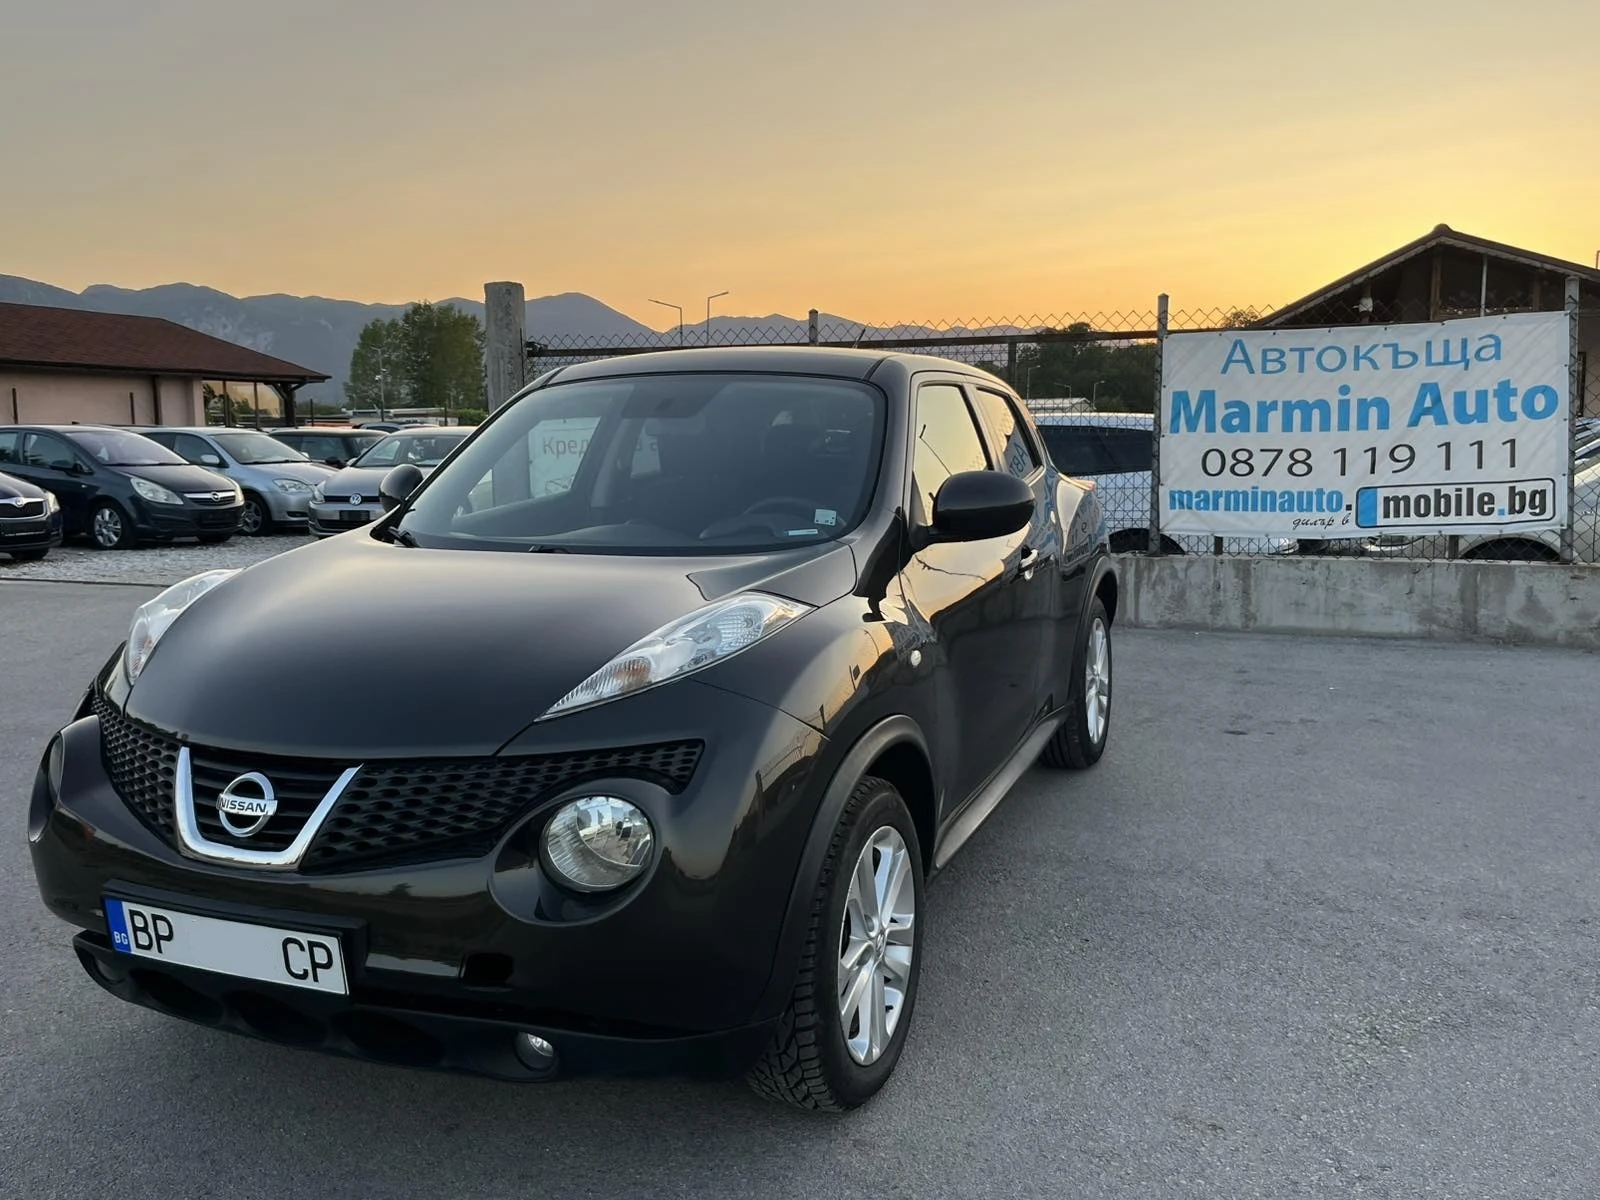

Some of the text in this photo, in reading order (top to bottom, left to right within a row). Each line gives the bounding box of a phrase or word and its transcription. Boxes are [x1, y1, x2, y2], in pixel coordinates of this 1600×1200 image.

[1220, 333, 1502, 375] Автокъща
[1169, 378, 1559, 434] Marmin Auto
[1201, 438, 1517, 477] 0878 119 111
[1382, 486, 1547, 519] mobile.bg
[219, 796, 267, 813] NISSAN
[113, 930, 129, 945] BG
